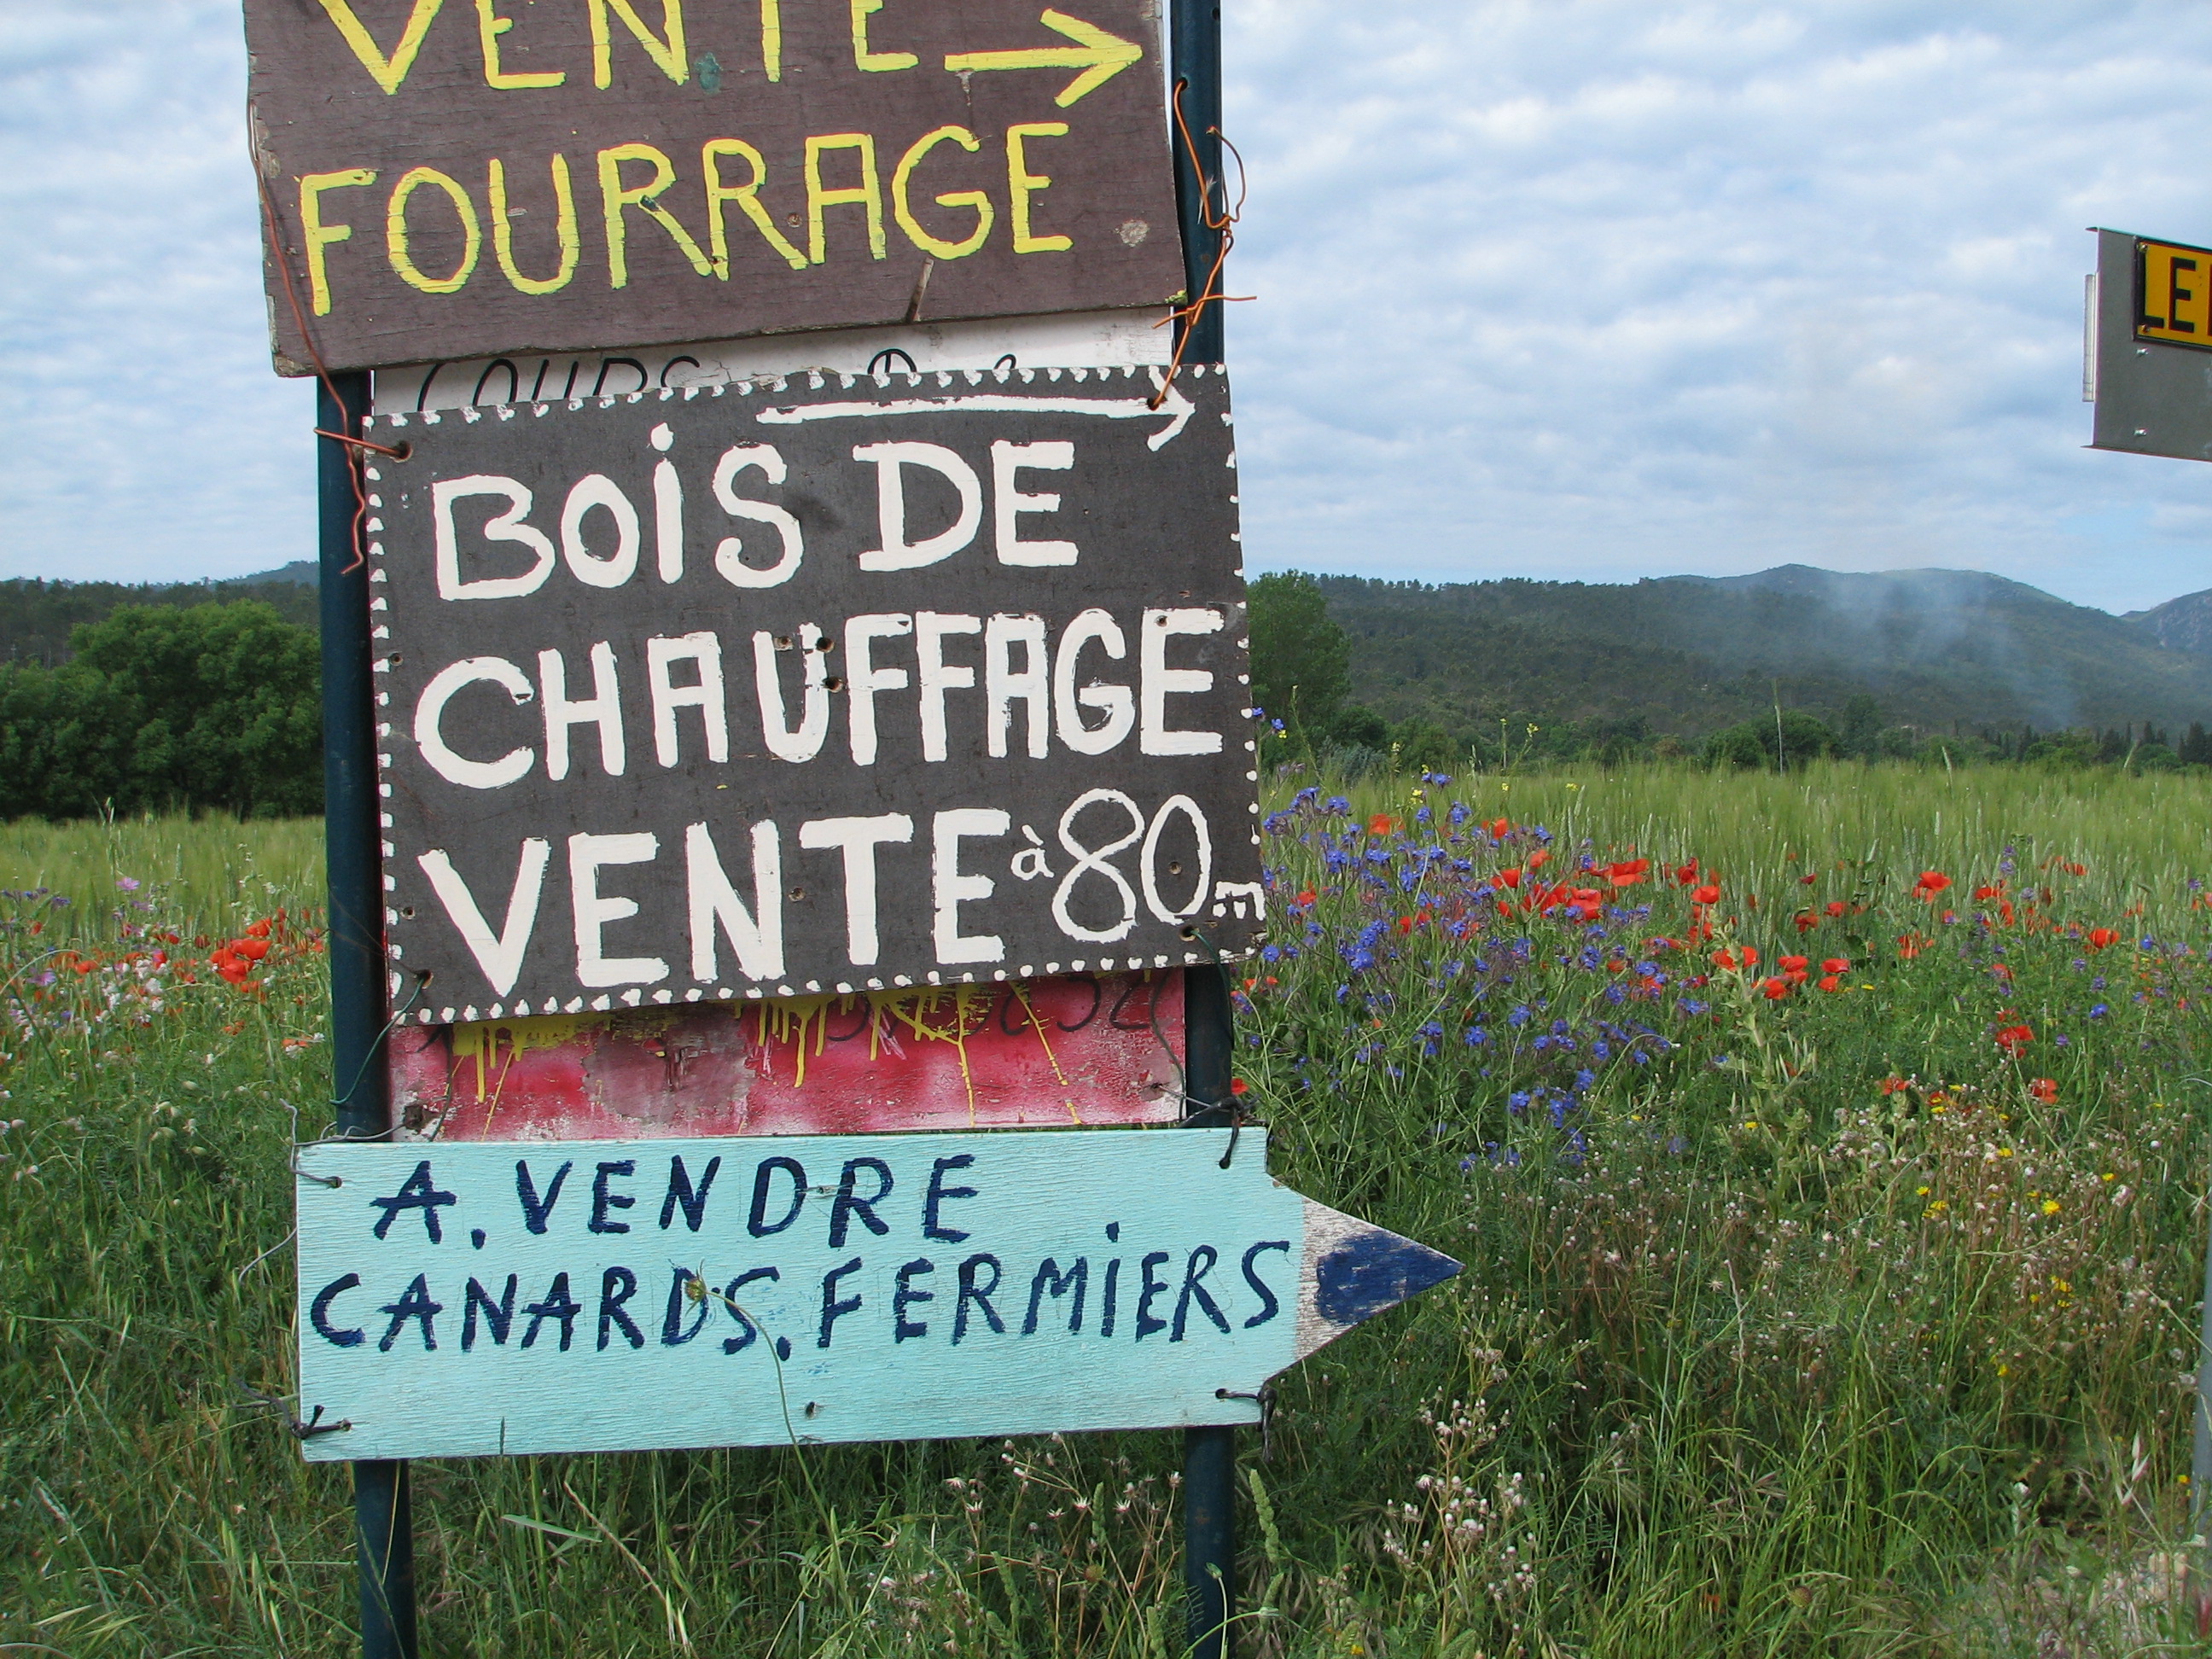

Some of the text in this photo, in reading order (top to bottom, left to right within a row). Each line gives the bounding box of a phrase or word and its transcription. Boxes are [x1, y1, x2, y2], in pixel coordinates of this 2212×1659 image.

[299, 122, 1074, 317] FOURRAGE
[2136, 250, 2212, 336] LE
[853, 439, 1079, 573] DE
[414, 608, 1225, 789] CHAUFFAGE
[418, 807, 1010, 997] VENTE
[515, 1154, 981, 1249] VENDRE
